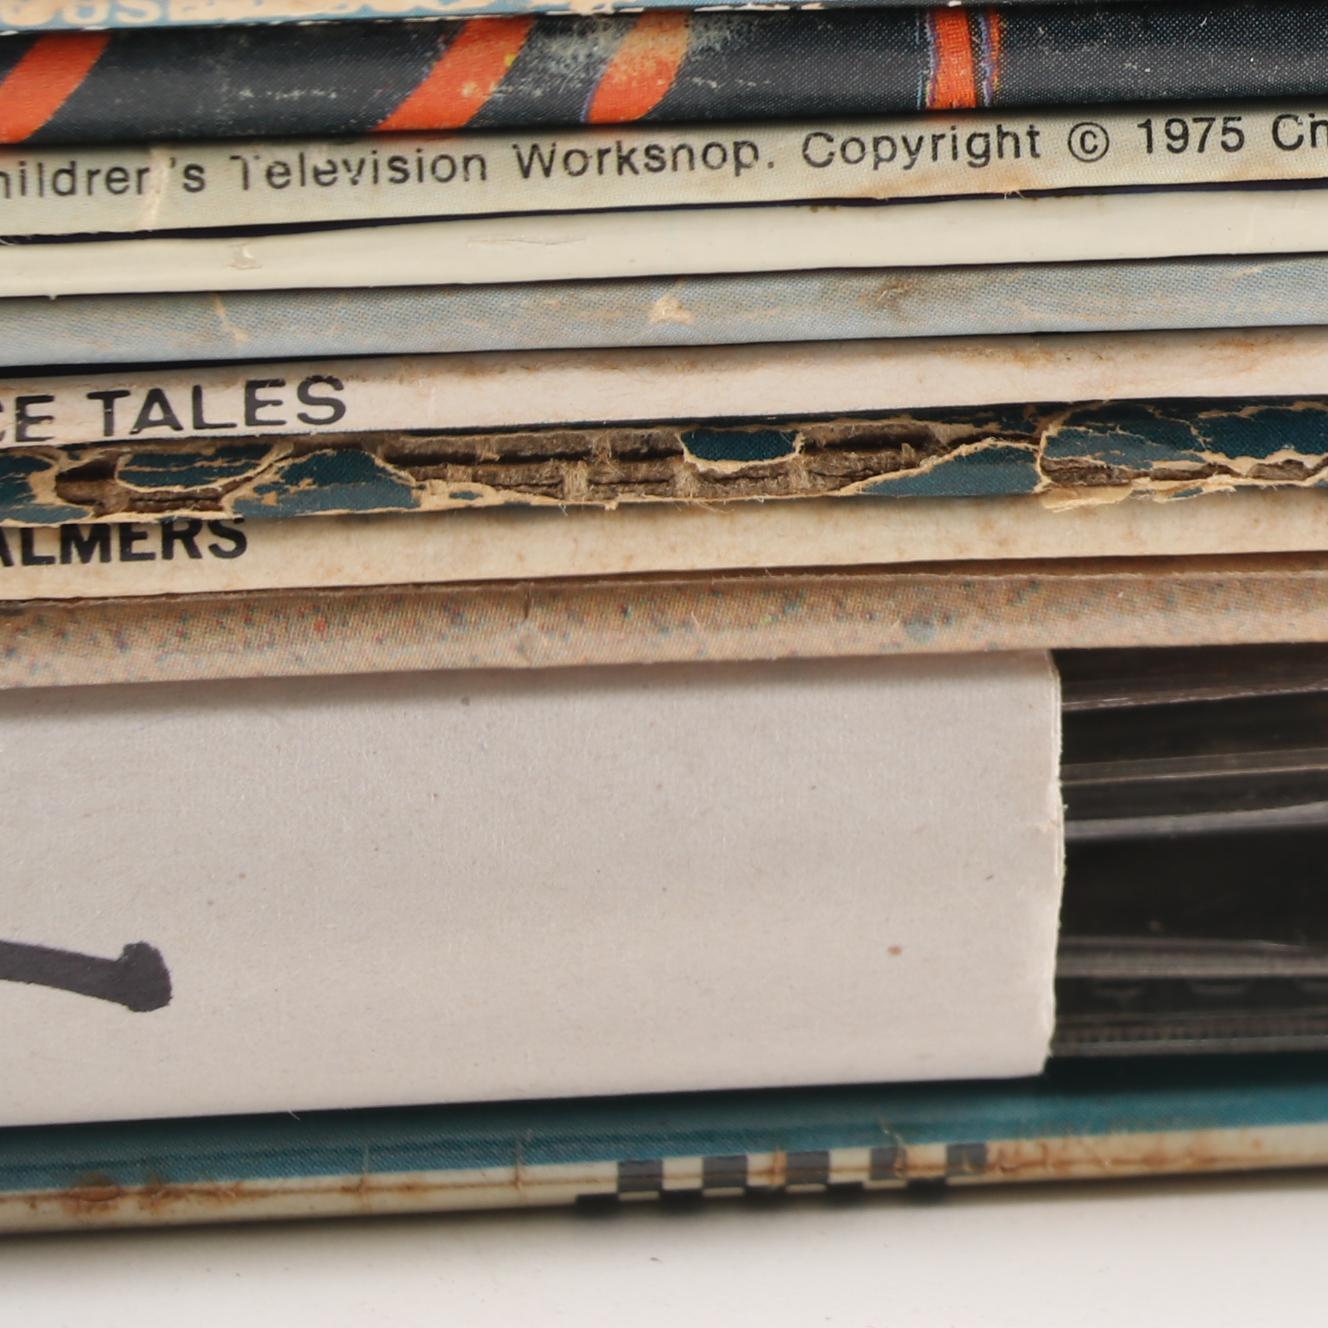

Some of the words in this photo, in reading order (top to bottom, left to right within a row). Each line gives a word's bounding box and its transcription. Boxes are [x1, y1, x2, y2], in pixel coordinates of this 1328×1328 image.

[232, 142, 487, 191] Television
[800, 122, 1041, 170] Copyright
[1136, 116, 1247, 154] 1975
[87, 375, 347, 437] TALES
